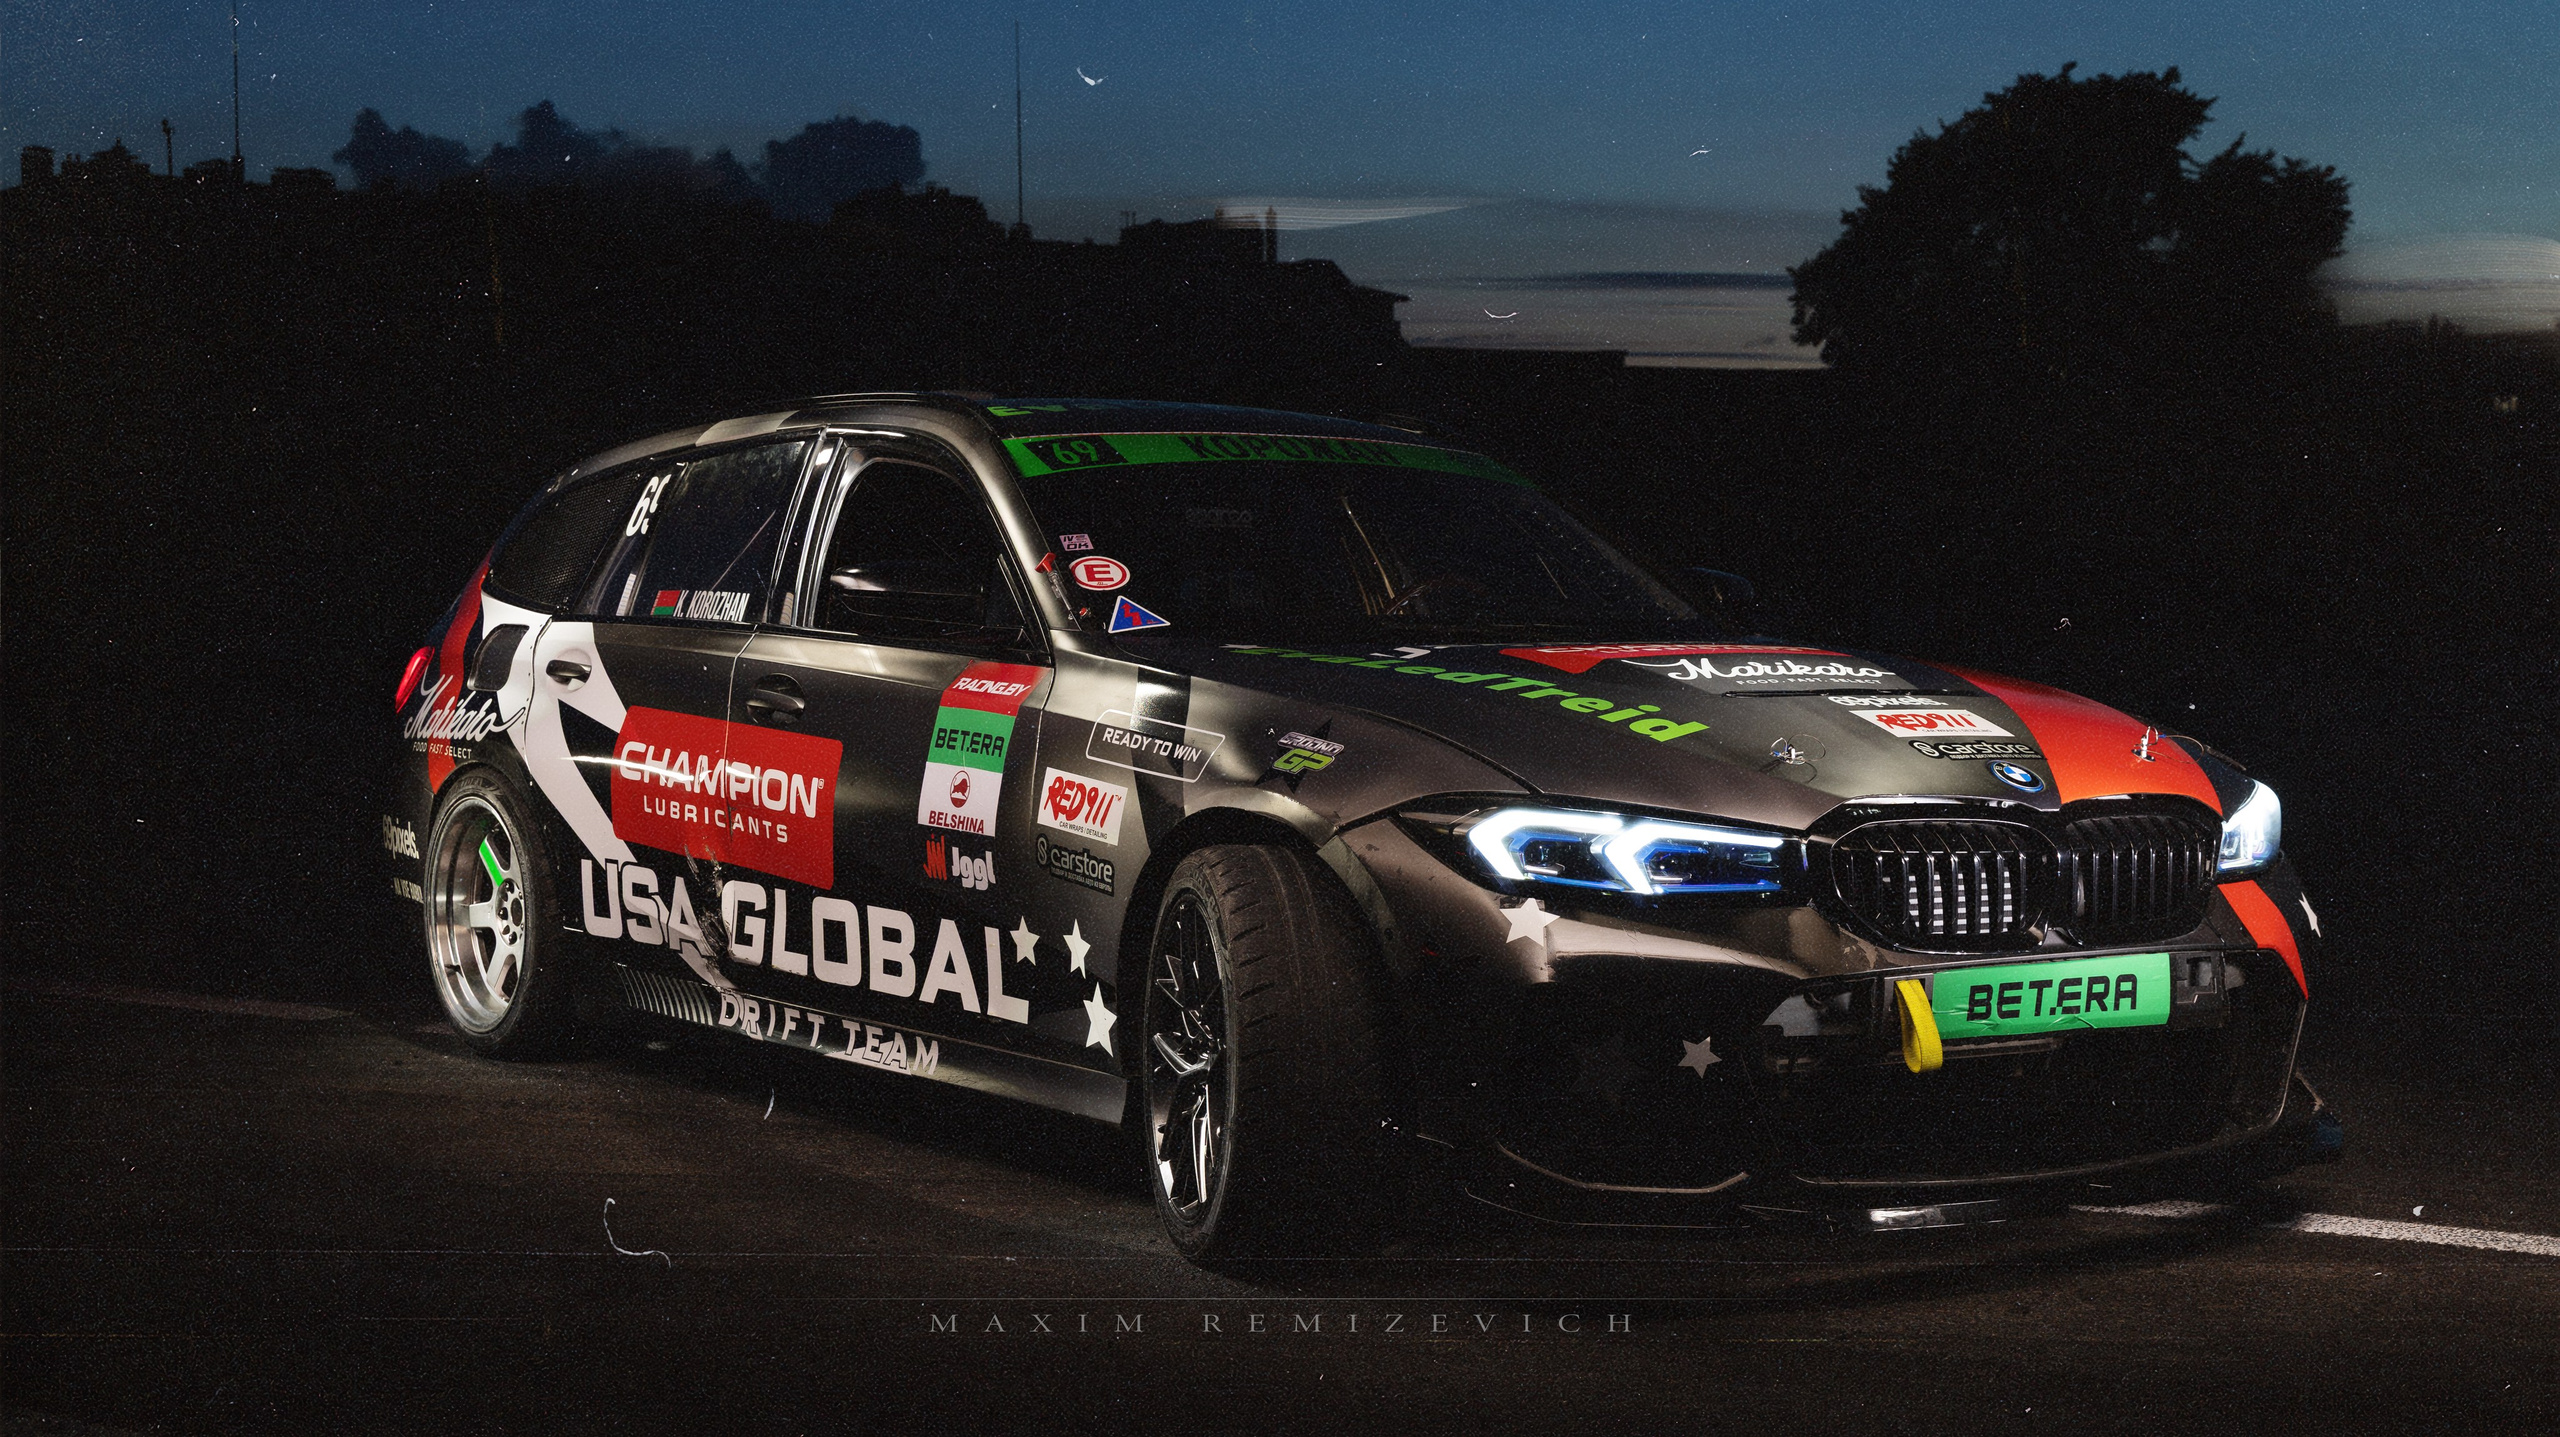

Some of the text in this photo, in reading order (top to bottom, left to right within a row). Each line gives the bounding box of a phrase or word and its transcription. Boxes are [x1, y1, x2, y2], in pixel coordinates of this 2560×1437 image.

[1083, 564, 1115, 582] E
[673, 589, 751, 622] K. KOROZHAN
[1621, 656, 1896, 681] Marikaro
[404, 656, 526, 742] Marikaro
[444, 745, 472, 760] SELECT
[1102, 727, 1202, 762] READY TO WIN
[1938, 741, 2035, 755] carstore
[1273, 748, 1335, 774] GP
[643, 794, 788, 844] LUBRICANTS
[928, 810, 985, 834] BELSHINA
[1058, 820, 1069, 829] CAR
[1068, 822, 1084, 834] WRAPS
[1050, 848, 1113, 883] carstore
[581, 858, 1029, 1025] USA GLOBAL
[718, 992, 939, 1076] DRIFT TEAM
